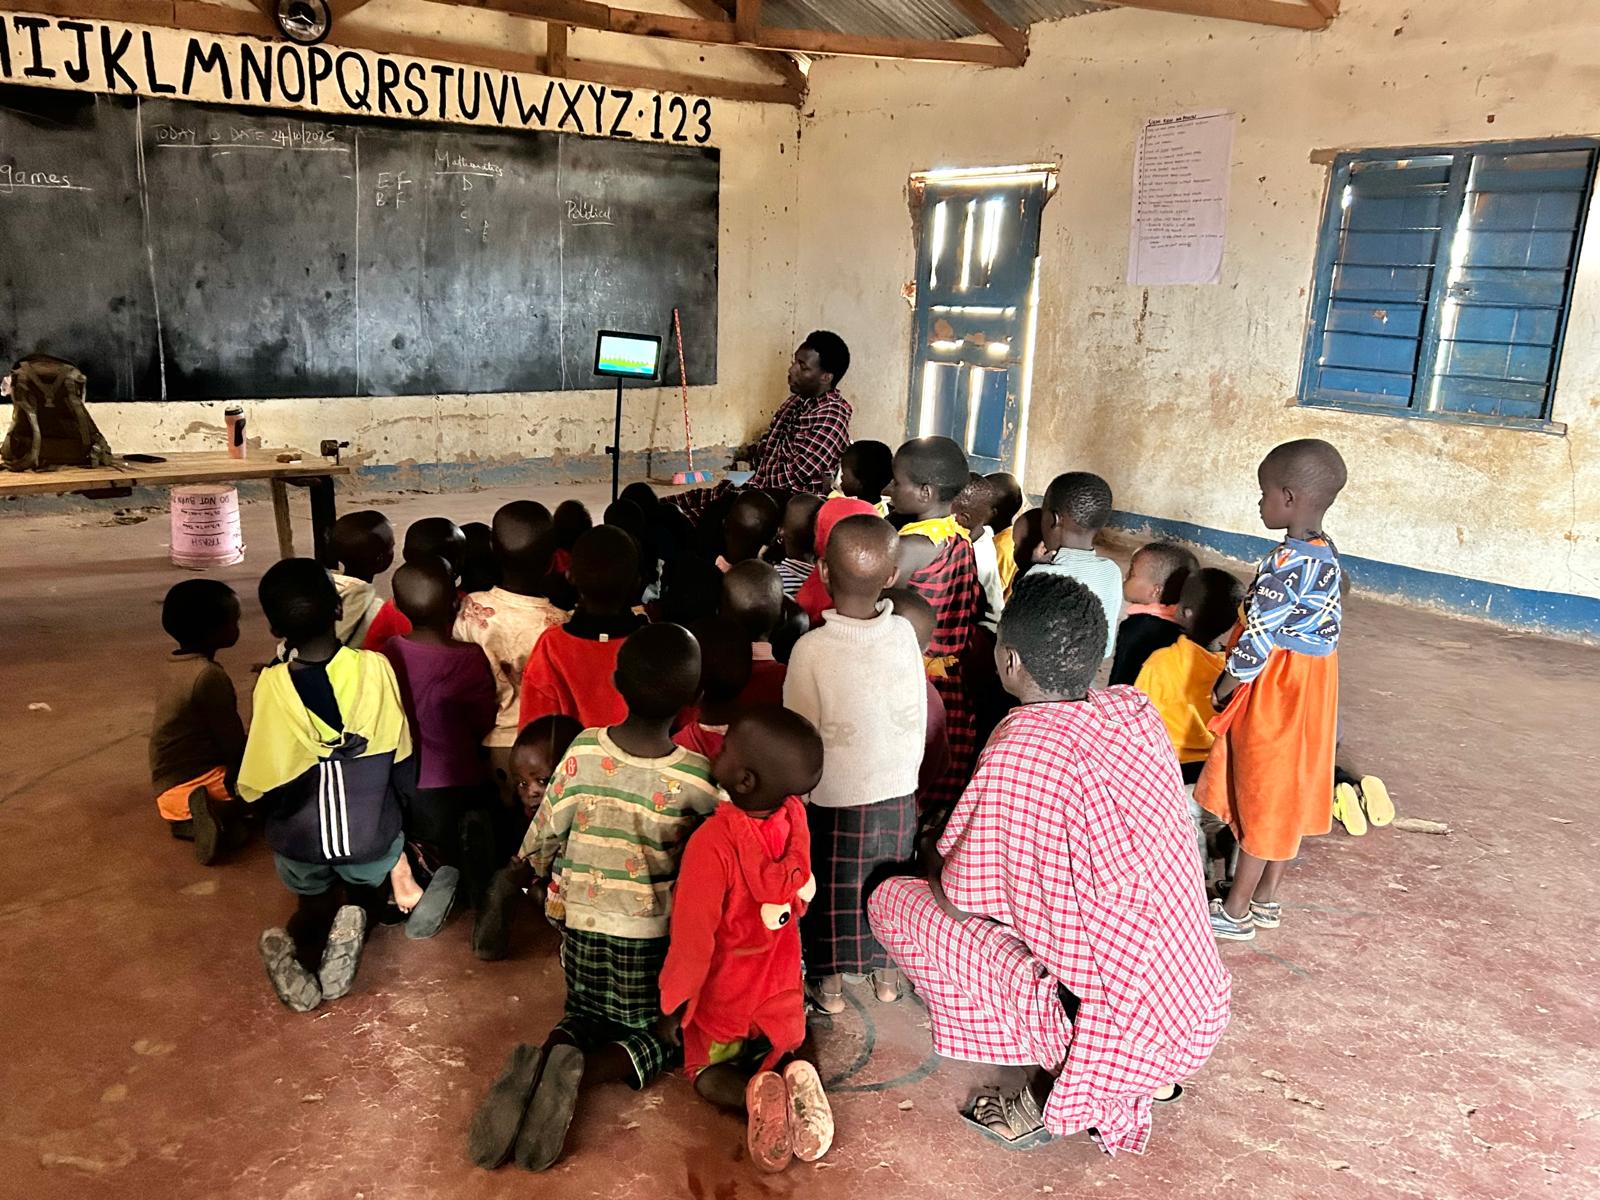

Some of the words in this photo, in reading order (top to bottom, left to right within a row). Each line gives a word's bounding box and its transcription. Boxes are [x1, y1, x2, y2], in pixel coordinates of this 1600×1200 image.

[0, 165, 71, 193] games
[1257, 585, 1285, 603] LOVE
[1231, 646, 1258, 665] LOVE
